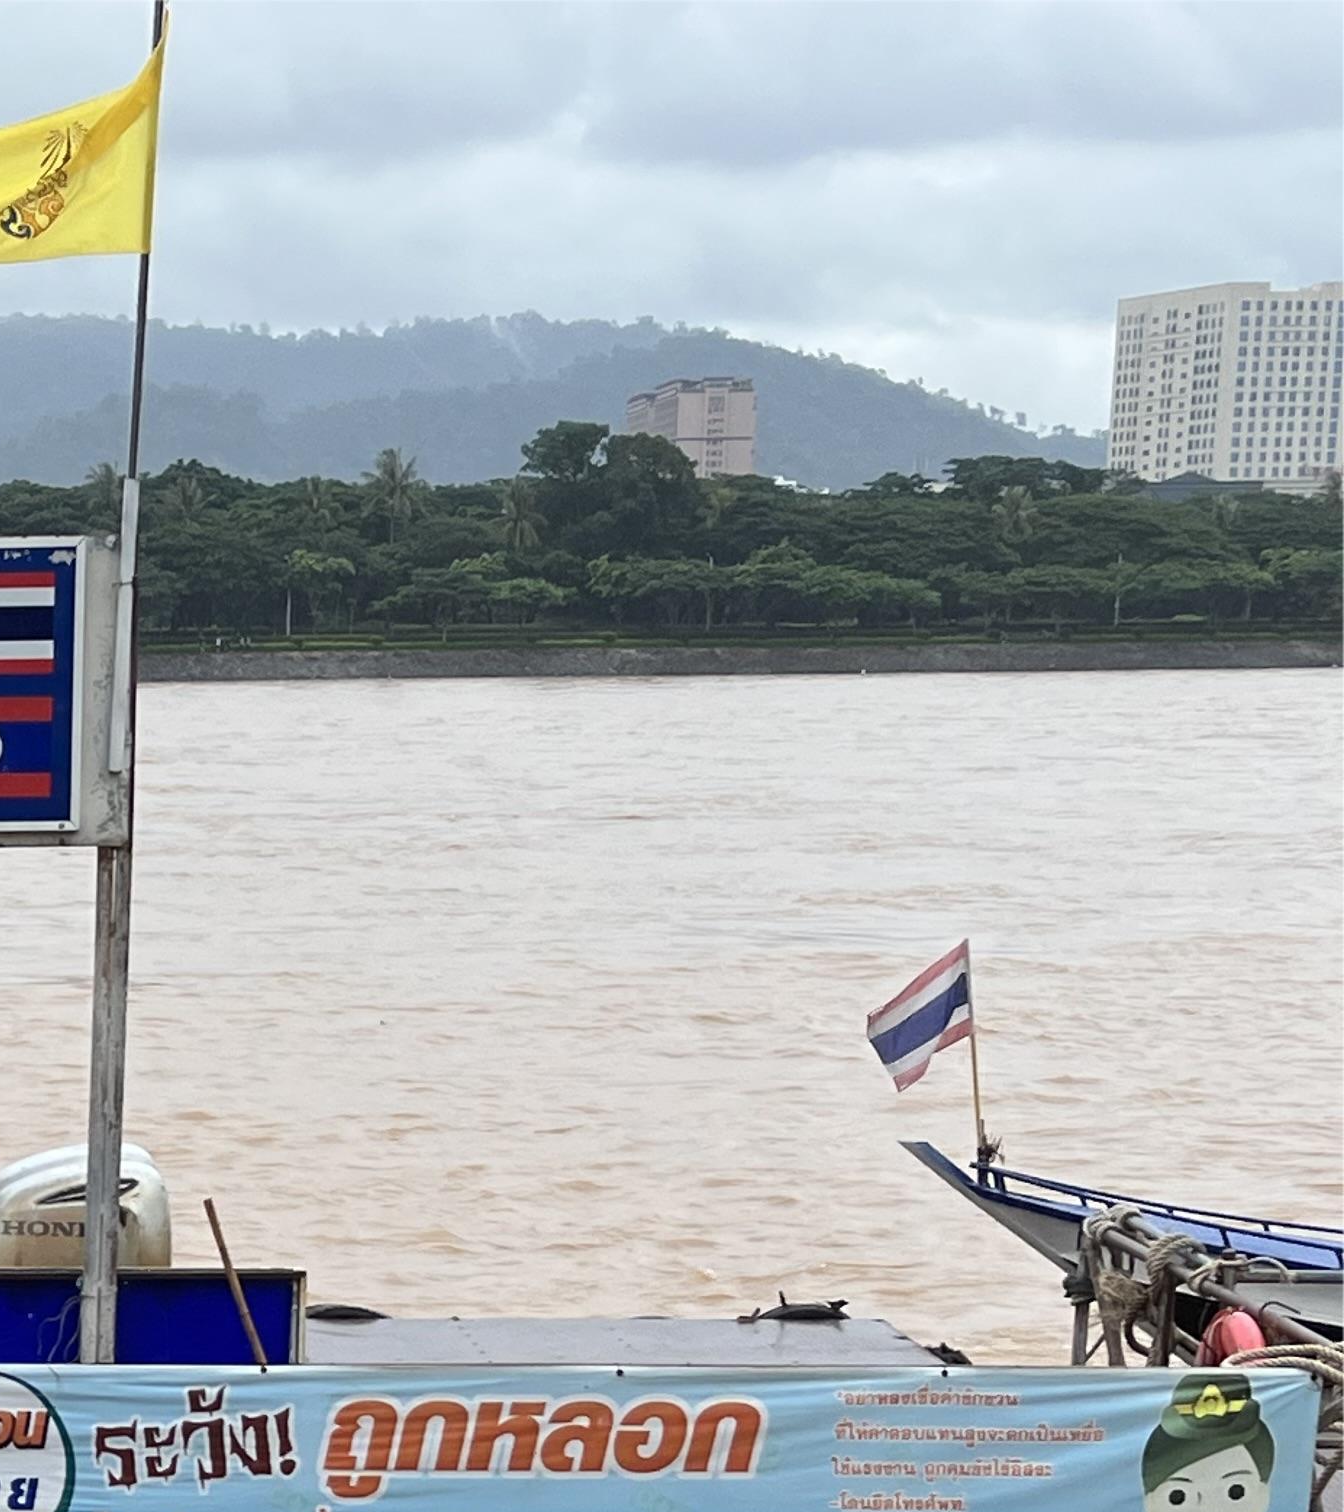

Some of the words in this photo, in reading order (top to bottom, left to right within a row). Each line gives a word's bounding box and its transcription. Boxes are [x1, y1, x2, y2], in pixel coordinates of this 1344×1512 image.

[1, 1220, 86, 1238] HON
[94, 1386, 297, 1490] ระวัง!
[322, 1396, 768, 1500] ถูกหลอก
